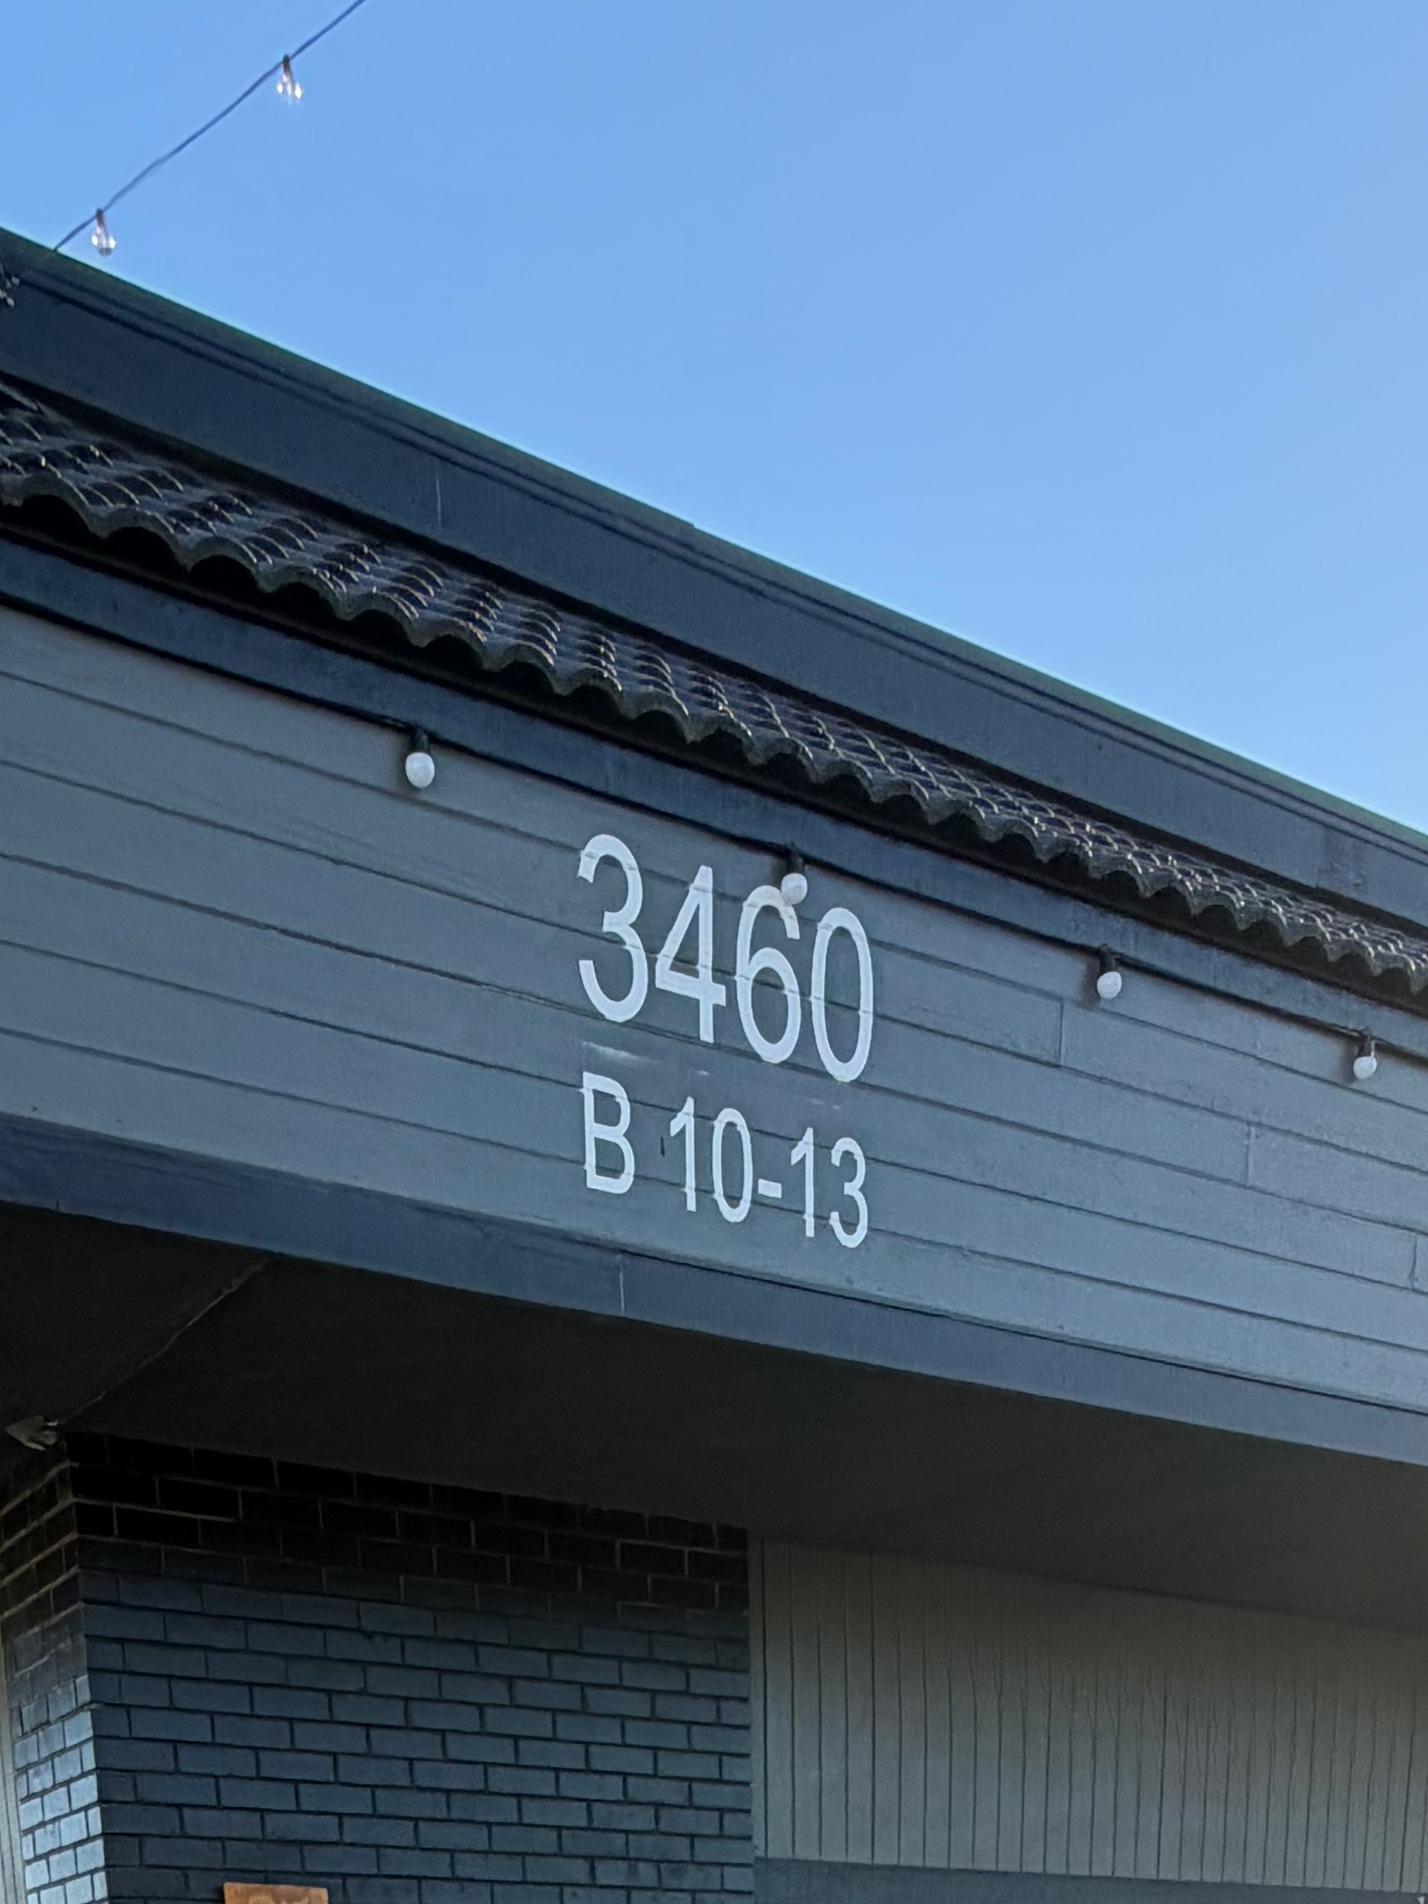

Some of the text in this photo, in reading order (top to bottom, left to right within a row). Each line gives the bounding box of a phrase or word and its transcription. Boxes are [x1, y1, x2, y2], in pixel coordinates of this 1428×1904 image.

[576, 833, 874, 1083] 3460
[582, 1071, 870, 1250] B 10-13
